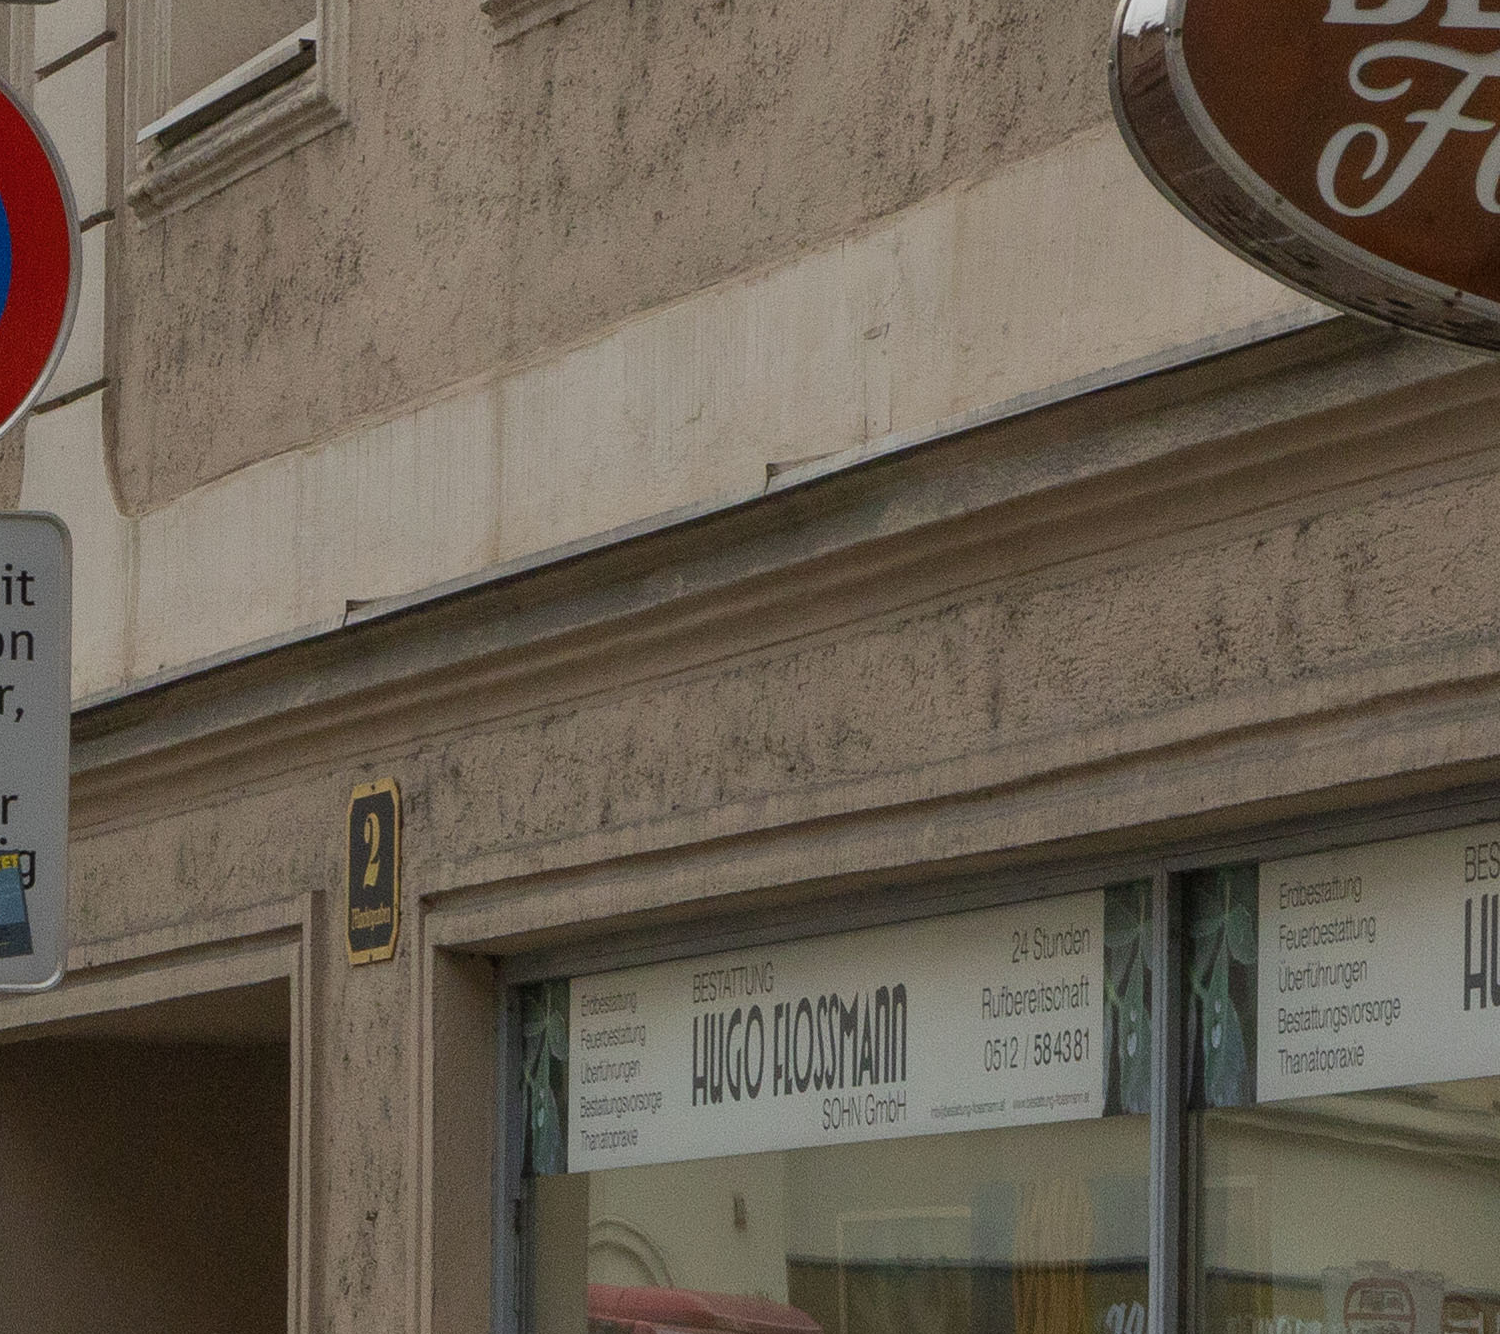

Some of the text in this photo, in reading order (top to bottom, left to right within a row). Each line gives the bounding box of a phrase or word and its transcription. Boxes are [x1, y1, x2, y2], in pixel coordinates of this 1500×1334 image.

[363, 812, 381, 888] 2
[1279, 874, 1363, 911] Erdbestattung
[1012, 922, 1092, 964] 24 Stunden
[1279, 915, 1377, 952] Feuerbestattung
[692, 962, 775, 1004] BESTATTUNG
[1279, 959, 1368, 993] Überführungen
[580, 990, 637, 1017] Erdbestattung
[981, 975, 1091, 1021] Rufbereitschaft
[1278, 995, 1402, 1035] Bestattungsvorsorge
[580, 1021, 646, 1050] Feuerbestattung
[580, 1055, 641, 1085] Überführungen
[692, 1011, 766, 1107] HUGO
[983, 1036, 1019, 1073] 0512
[1278, 1042, 1366, 1077] Thanatopraxie
[580, 1089, 663, 1120] Bestattungsvorsorge
[822, 1089, 907, 1131] SOHN GmbH
[580, 1126, 639, 1154] Thanatopraxie
